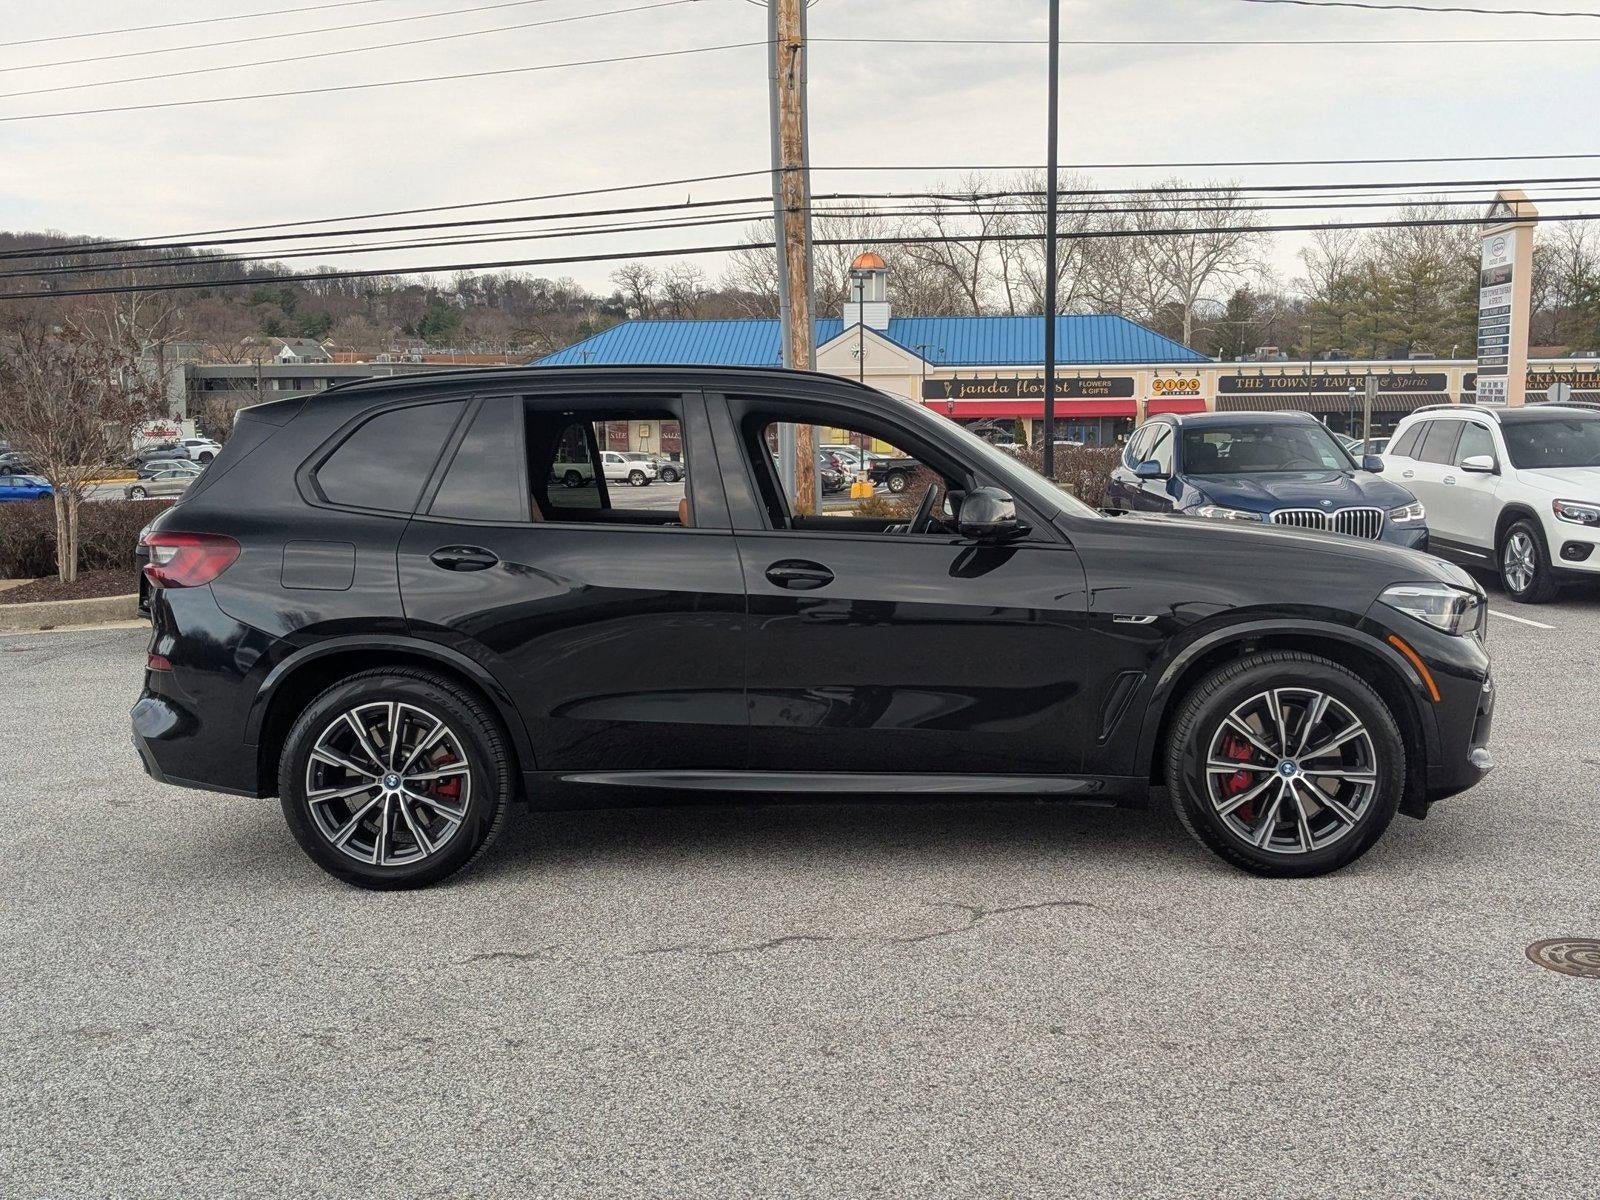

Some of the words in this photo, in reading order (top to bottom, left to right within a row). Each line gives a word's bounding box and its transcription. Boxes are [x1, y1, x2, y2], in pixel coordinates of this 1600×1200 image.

[1236, 378, 1264, 388] THE
[1269, 377, 1318, 388] TOWNE
[1323, 377, 1365, 387] TAVER
[1379, 377, 1390, 387] &
[1392, 376, 1429, 388] Spirits
[1527, 374, 1600, 383] CKEYSVILLE
[959, 380, 1010, 397] janda
[1016, 380, 1071, 396] florst
[1154, 380, 1198, 389] ZIPS
[609, 432, 628, 440] SALE
[661, 432, 681, 440] SALE
